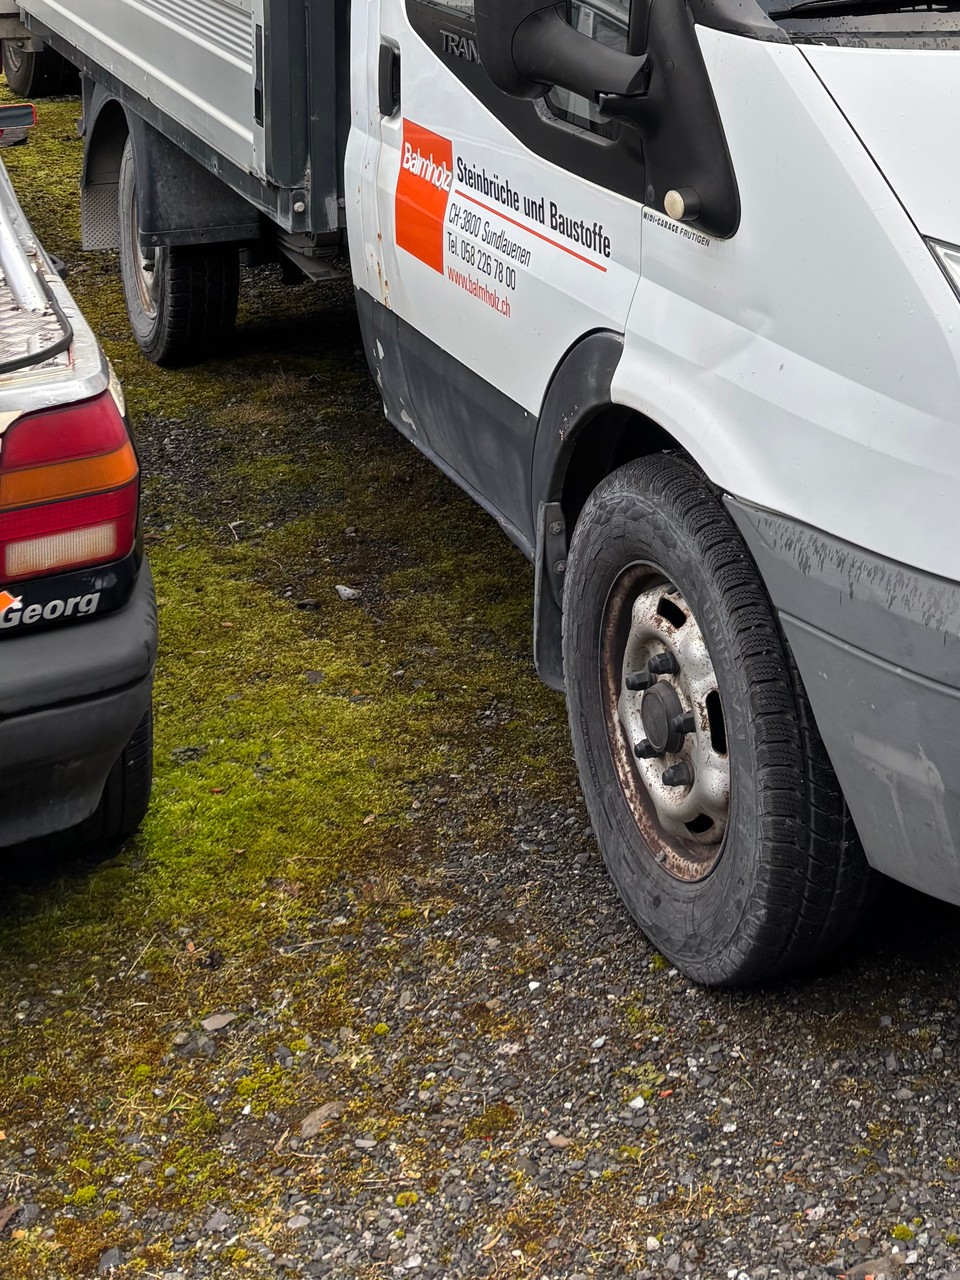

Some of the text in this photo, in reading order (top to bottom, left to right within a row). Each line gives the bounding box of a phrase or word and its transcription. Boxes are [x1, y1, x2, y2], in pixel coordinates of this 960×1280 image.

[403, 141, 452, 192] Balmholz
[457, 156, 612, 259] Steinbrüche und Baustoffe
[447, 231, 516, 291] Tel. 058 226 78 00
[448, 203, 532, 267] CH-3800 Sundlauenen
[679, 228, 711, 248] FRUTIGEN
[447, 266, 511, 318] www.balmholz.ch
[0, 592, 100, 630] Georg
